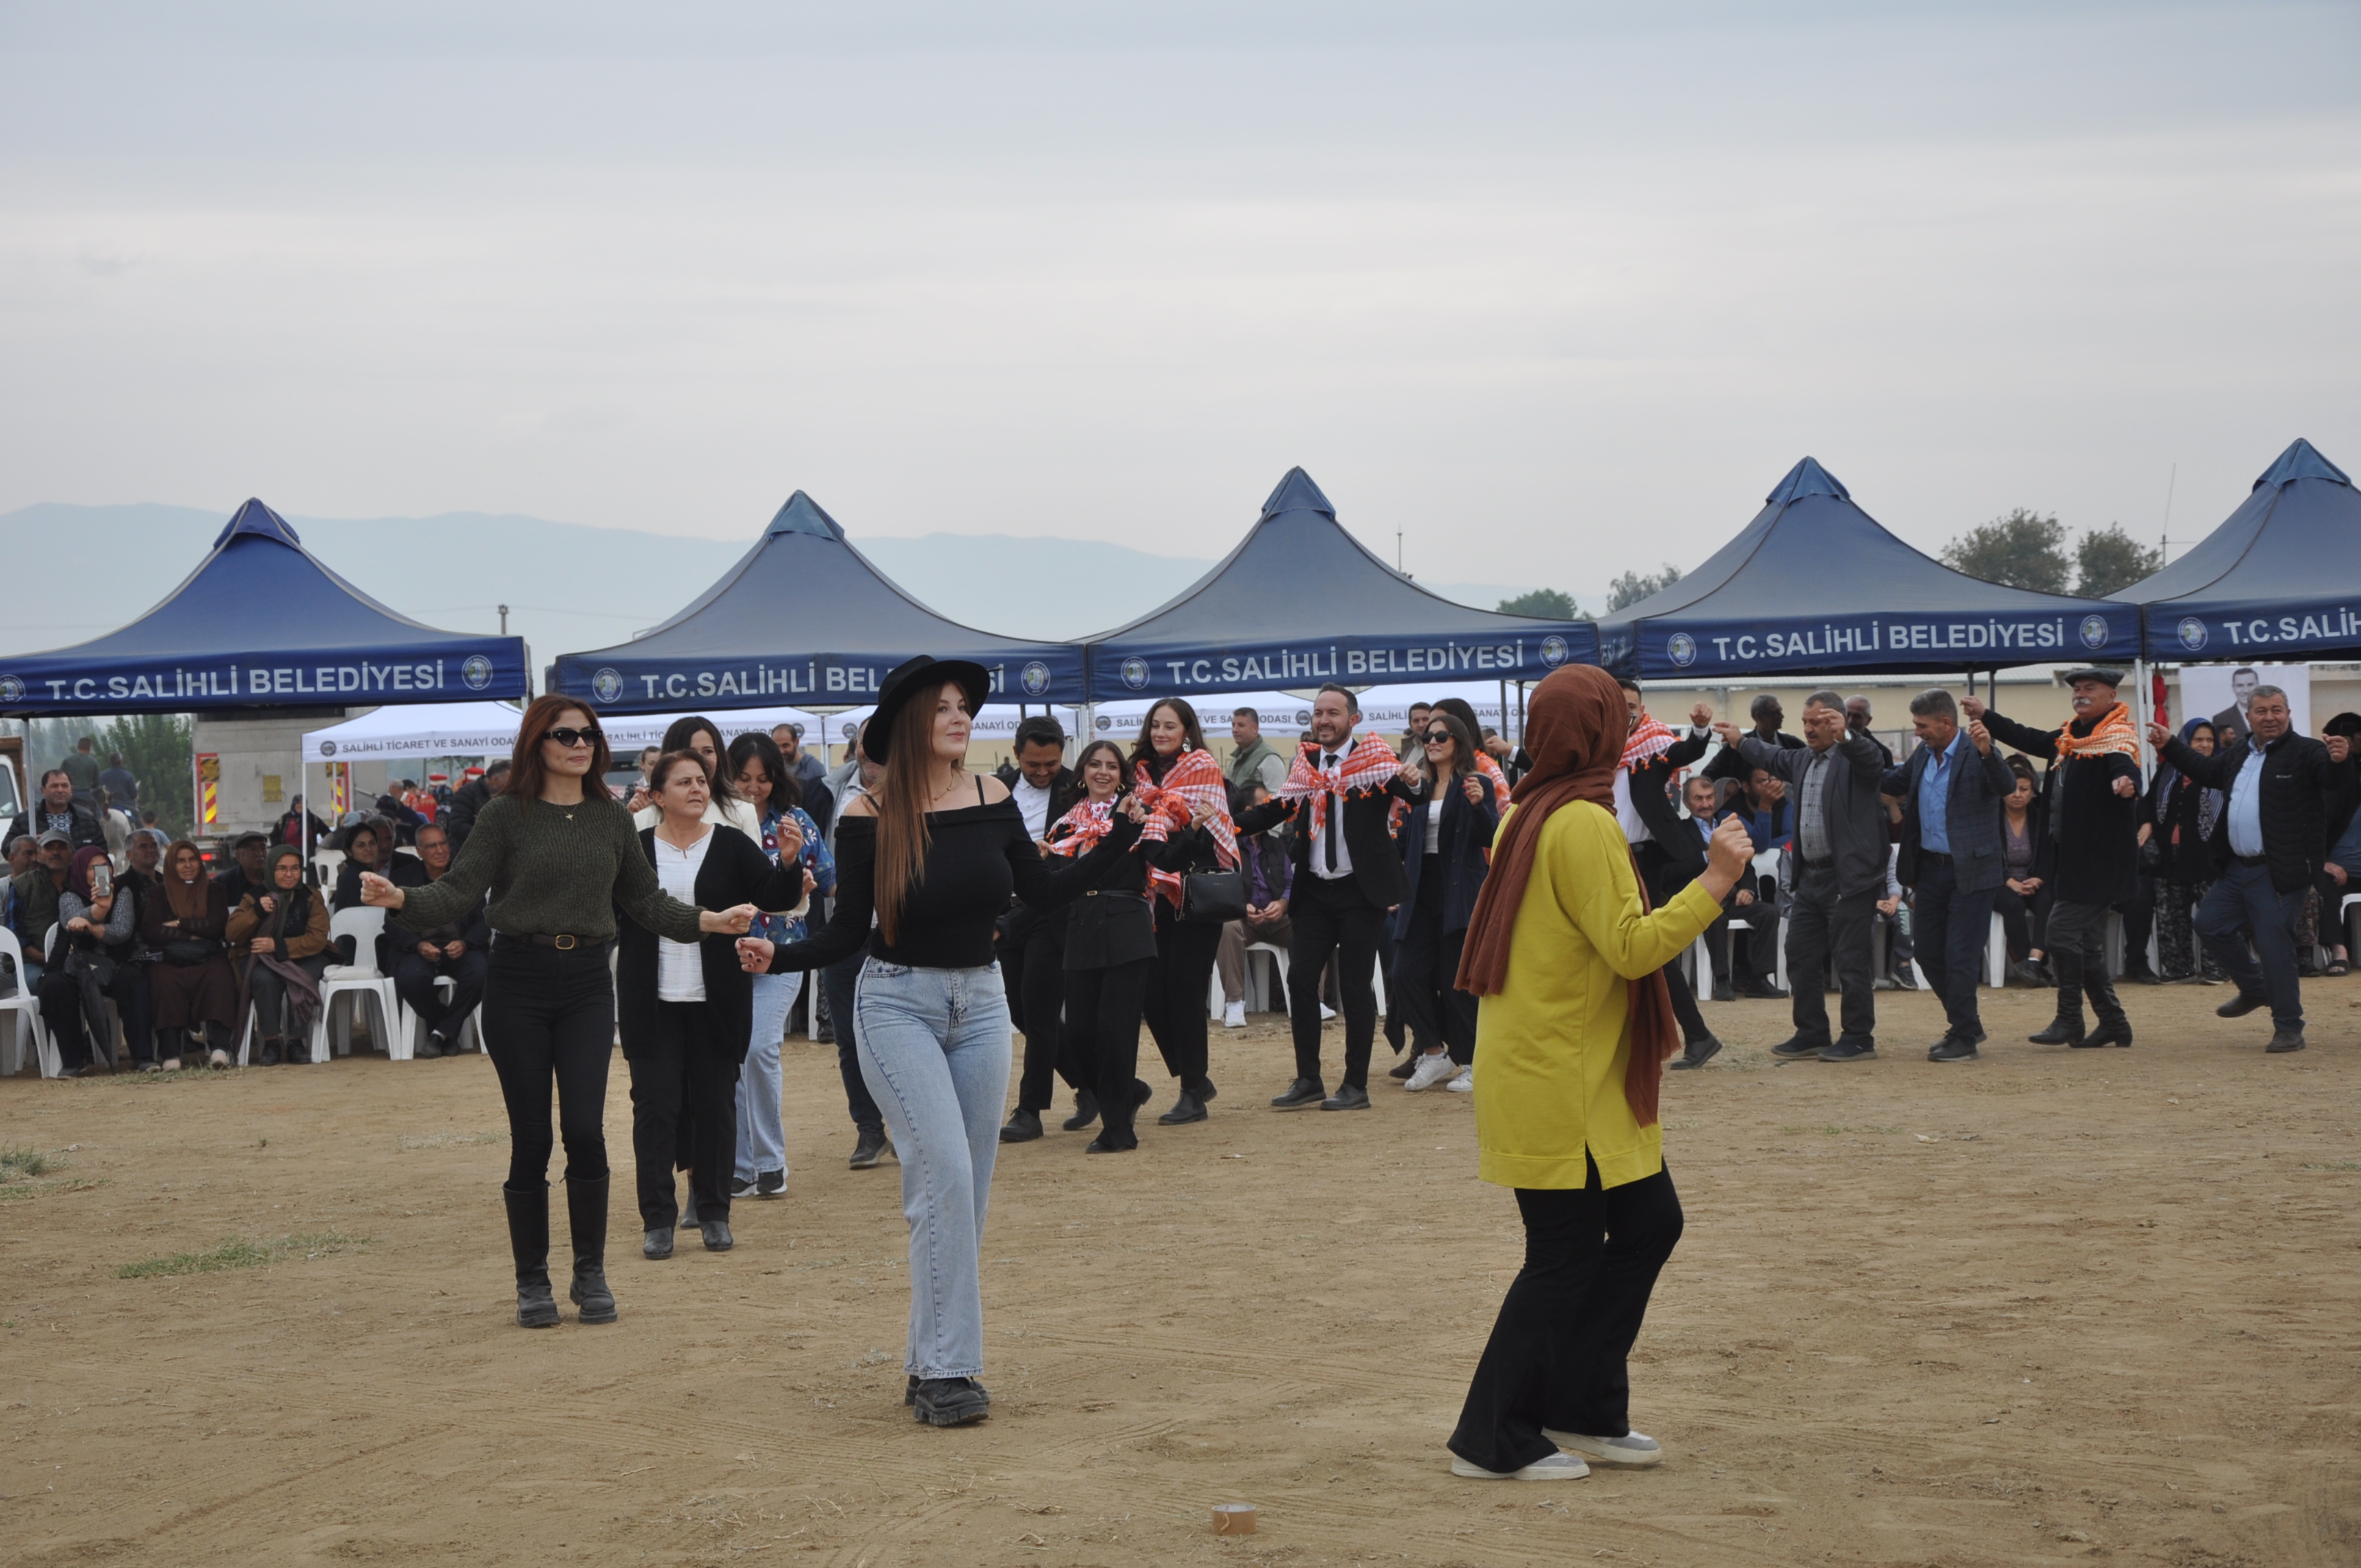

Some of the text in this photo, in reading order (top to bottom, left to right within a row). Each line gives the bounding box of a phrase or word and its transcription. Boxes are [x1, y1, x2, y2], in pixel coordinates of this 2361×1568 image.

[1889, 618, 2063, 649] BELEDİYESİ
[2223, 607, 2361, 644] T.C.SALİH
[1347, 639, 1523, 674] BELEDİYESİ
[250, 659, 443, 694] BELEDİYESİ
[1117, 716, 1145, 727] SALİH
[1204, 715, 1217, 723] VE
[1259, 715, 1291, 723] ODASI
[1368, 710, 1407, 721] SALİHLİ
[342, 741, 382, 753] SALİHLİ
[385, 739, 431, 750] TİCARET
[433, 739, 447, 747] VE
[450, 736, 488, 747] SANAYİ
[490, 737, 514, 746] ODA
[607, 730, 646, 741] SALİHLİ
